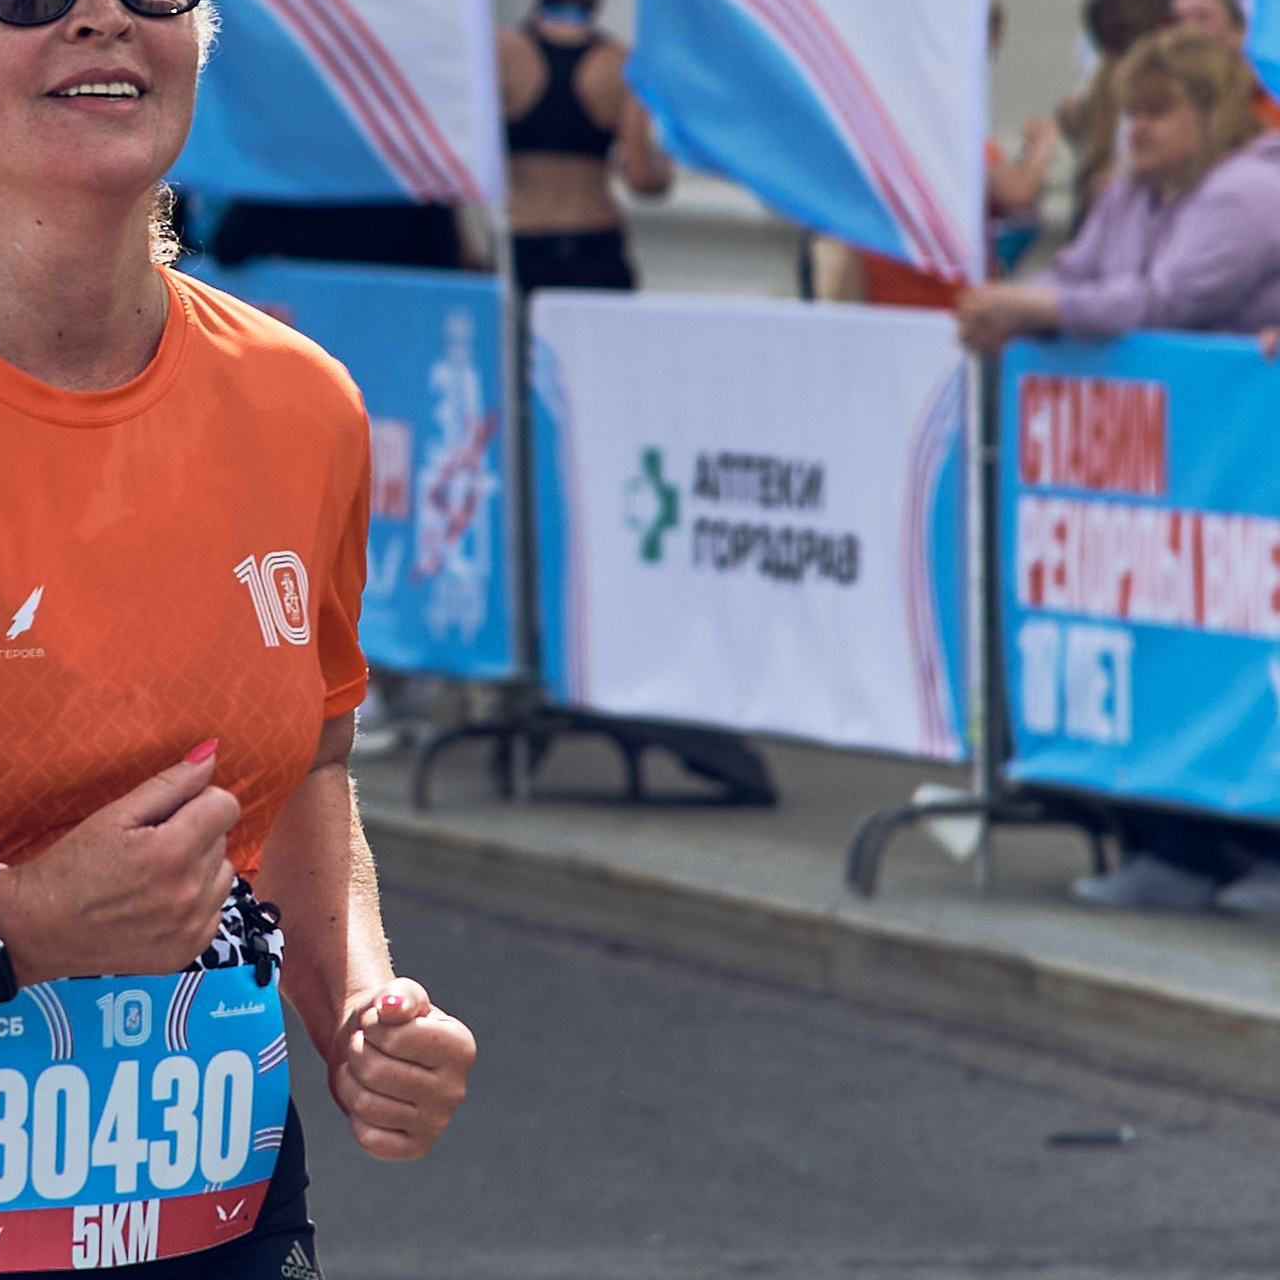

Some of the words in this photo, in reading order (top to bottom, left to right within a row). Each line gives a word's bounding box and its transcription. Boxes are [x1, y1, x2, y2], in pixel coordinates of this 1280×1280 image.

[693, 448, 825, 510] АПТЕКИ
[233, 551, 311, 648] 10
[96, 989, 153, 1049] 10
[72, 1199, 161, 1270] 5KM
